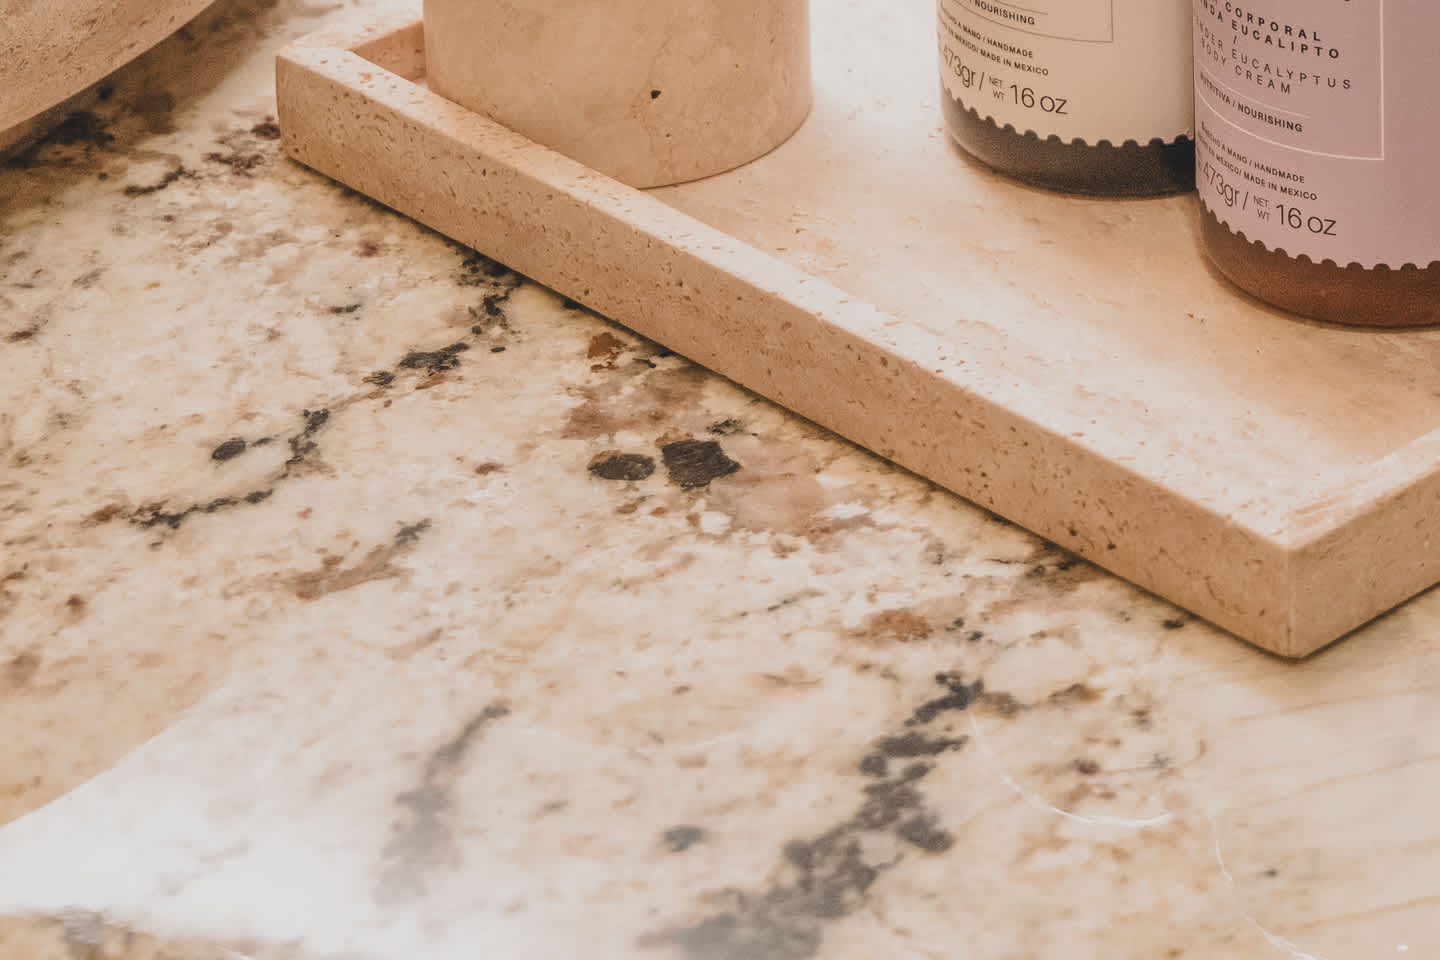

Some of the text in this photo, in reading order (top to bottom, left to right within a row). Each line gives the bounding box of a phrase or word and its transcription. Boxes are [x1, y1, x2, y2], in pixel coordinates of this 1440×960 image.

[1224, 1, 1321, 42] CORPORAL
[986, 39, 1033, 59] HANDMADE
[1231, 18, 1340, 59] EUCALIPTO
[979, 48, 1001, 63] MADE
[1003, 57, 1012, 68] IN
[1013, 61, 1049, 76] MEXICO
[1231, 48, 1351, 90] EUCALYPTUS
[1234, 64, 1291, 95] CREAM
[1009, 84, 1036, 109] 16
[1237, 101, 1304, 133] NOURISHING
[1227, 147, 1248, 165] MANO
[1254, 159, 1305, 184] HANDMADE
[1203, 161, 1240, 207] 473gr
[1243, 170, 1266, 189] MADE
[1268, 182, 1278, 192] IN
[1279, 185, 1318, 201] MEXICO
[1257, 209, 1271, 222] WT
[1276, 204, 1302, 230] 16
